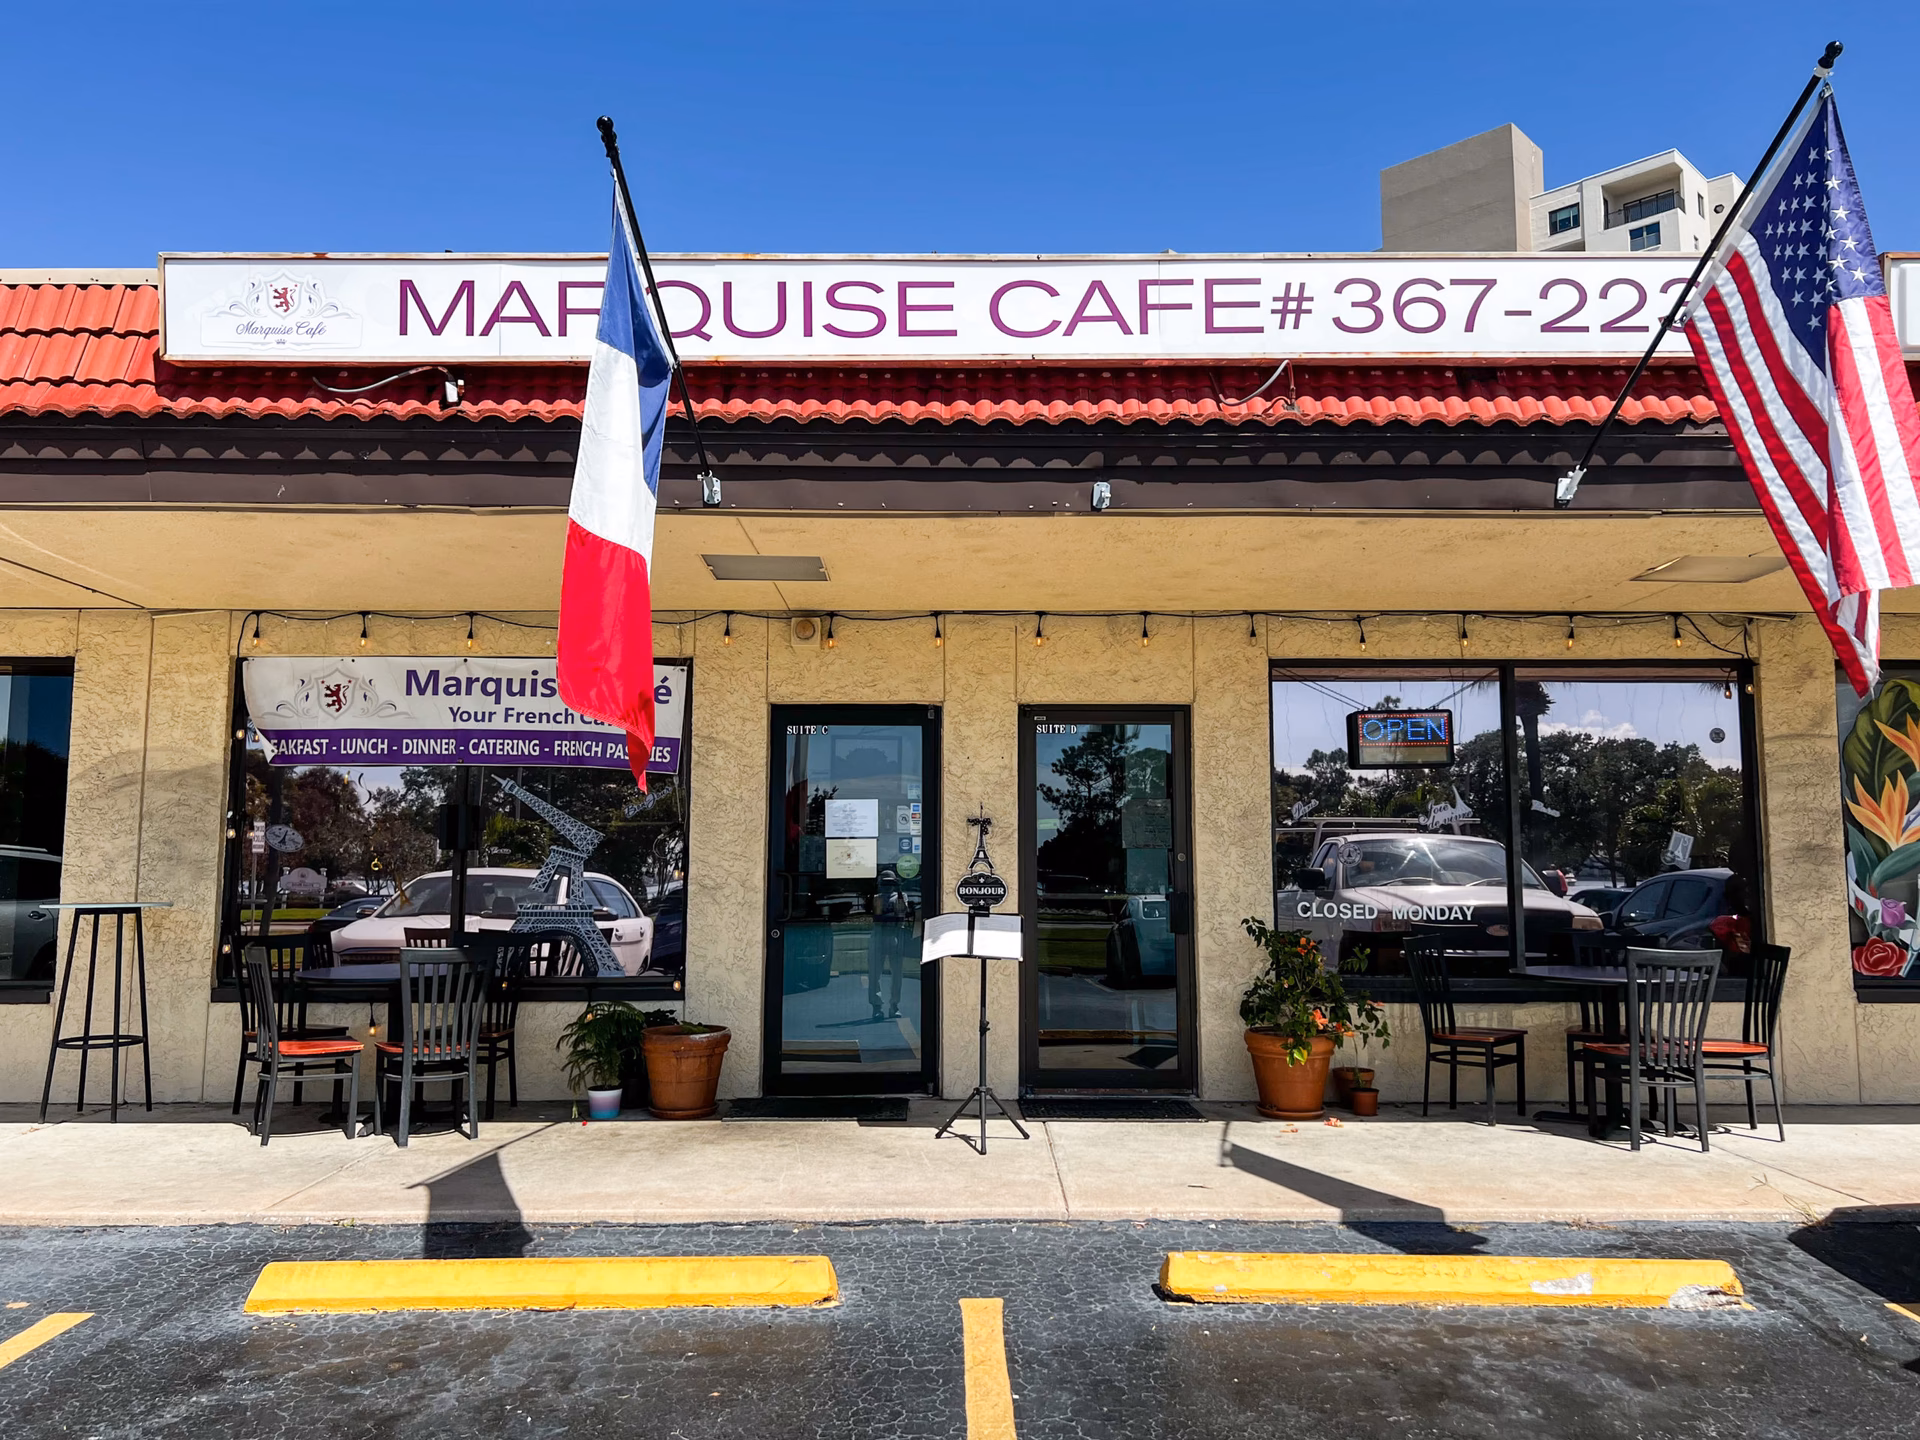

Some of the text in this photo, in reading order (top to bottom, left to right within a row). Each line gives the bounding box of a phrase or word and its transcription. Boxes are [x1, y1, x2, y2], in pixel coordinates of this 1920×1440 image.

[398, 278, 958, 342] MARQUISE
[236, 320, 327, 340] Marquise Café
[405, 669, 558, 704] Marquis
[448, 706, 497, 723] Your
[503, 707, 575, 725] French
[786, 725, 829, 735] SUITE C
[1036, 724, 1077, 734] SUITE D
[1363, 718, 1446, 741] OPEN
[271, 738, 330, 755] EAKFAST
[340, 738, 389, 755] LUNCH
[402, 738, 457, 755] DINNER
[468, 738, 540, 756] CATERING
[554, 740, 602, 758] FRENCH
[959, 886, 1005, 895] BONJOUR
[1296, 901, 1476, 922] CLOSED MONDAY
